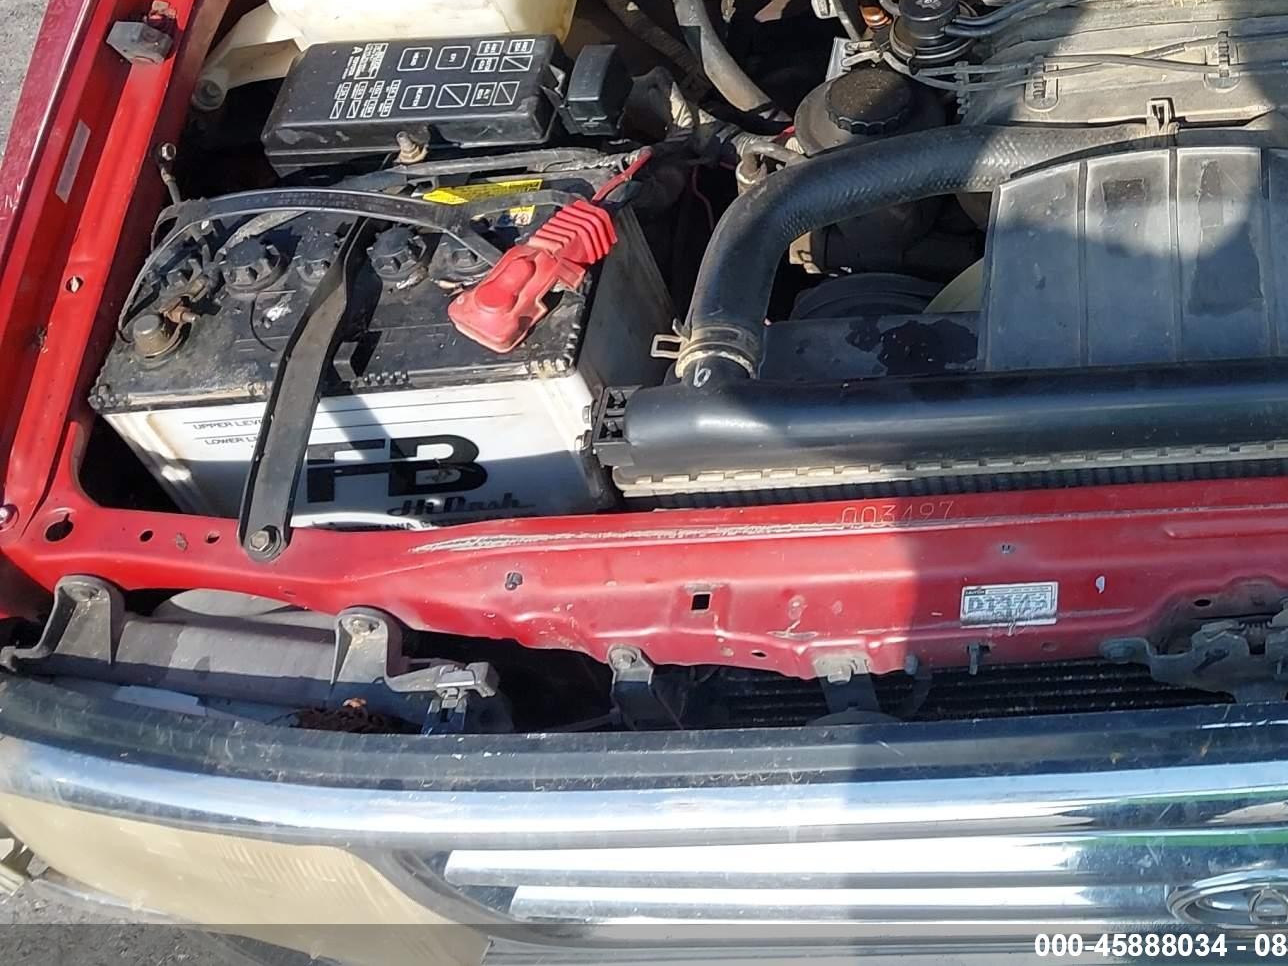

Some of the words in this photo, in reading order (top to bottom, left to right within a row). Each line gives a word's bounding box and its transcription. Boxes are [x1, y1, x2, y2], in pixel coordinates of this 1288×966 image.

[193, 421, 233, 430] UPPER
[204, 436, 245, 445] LOWER
[307, 434, 489, 504] FB
